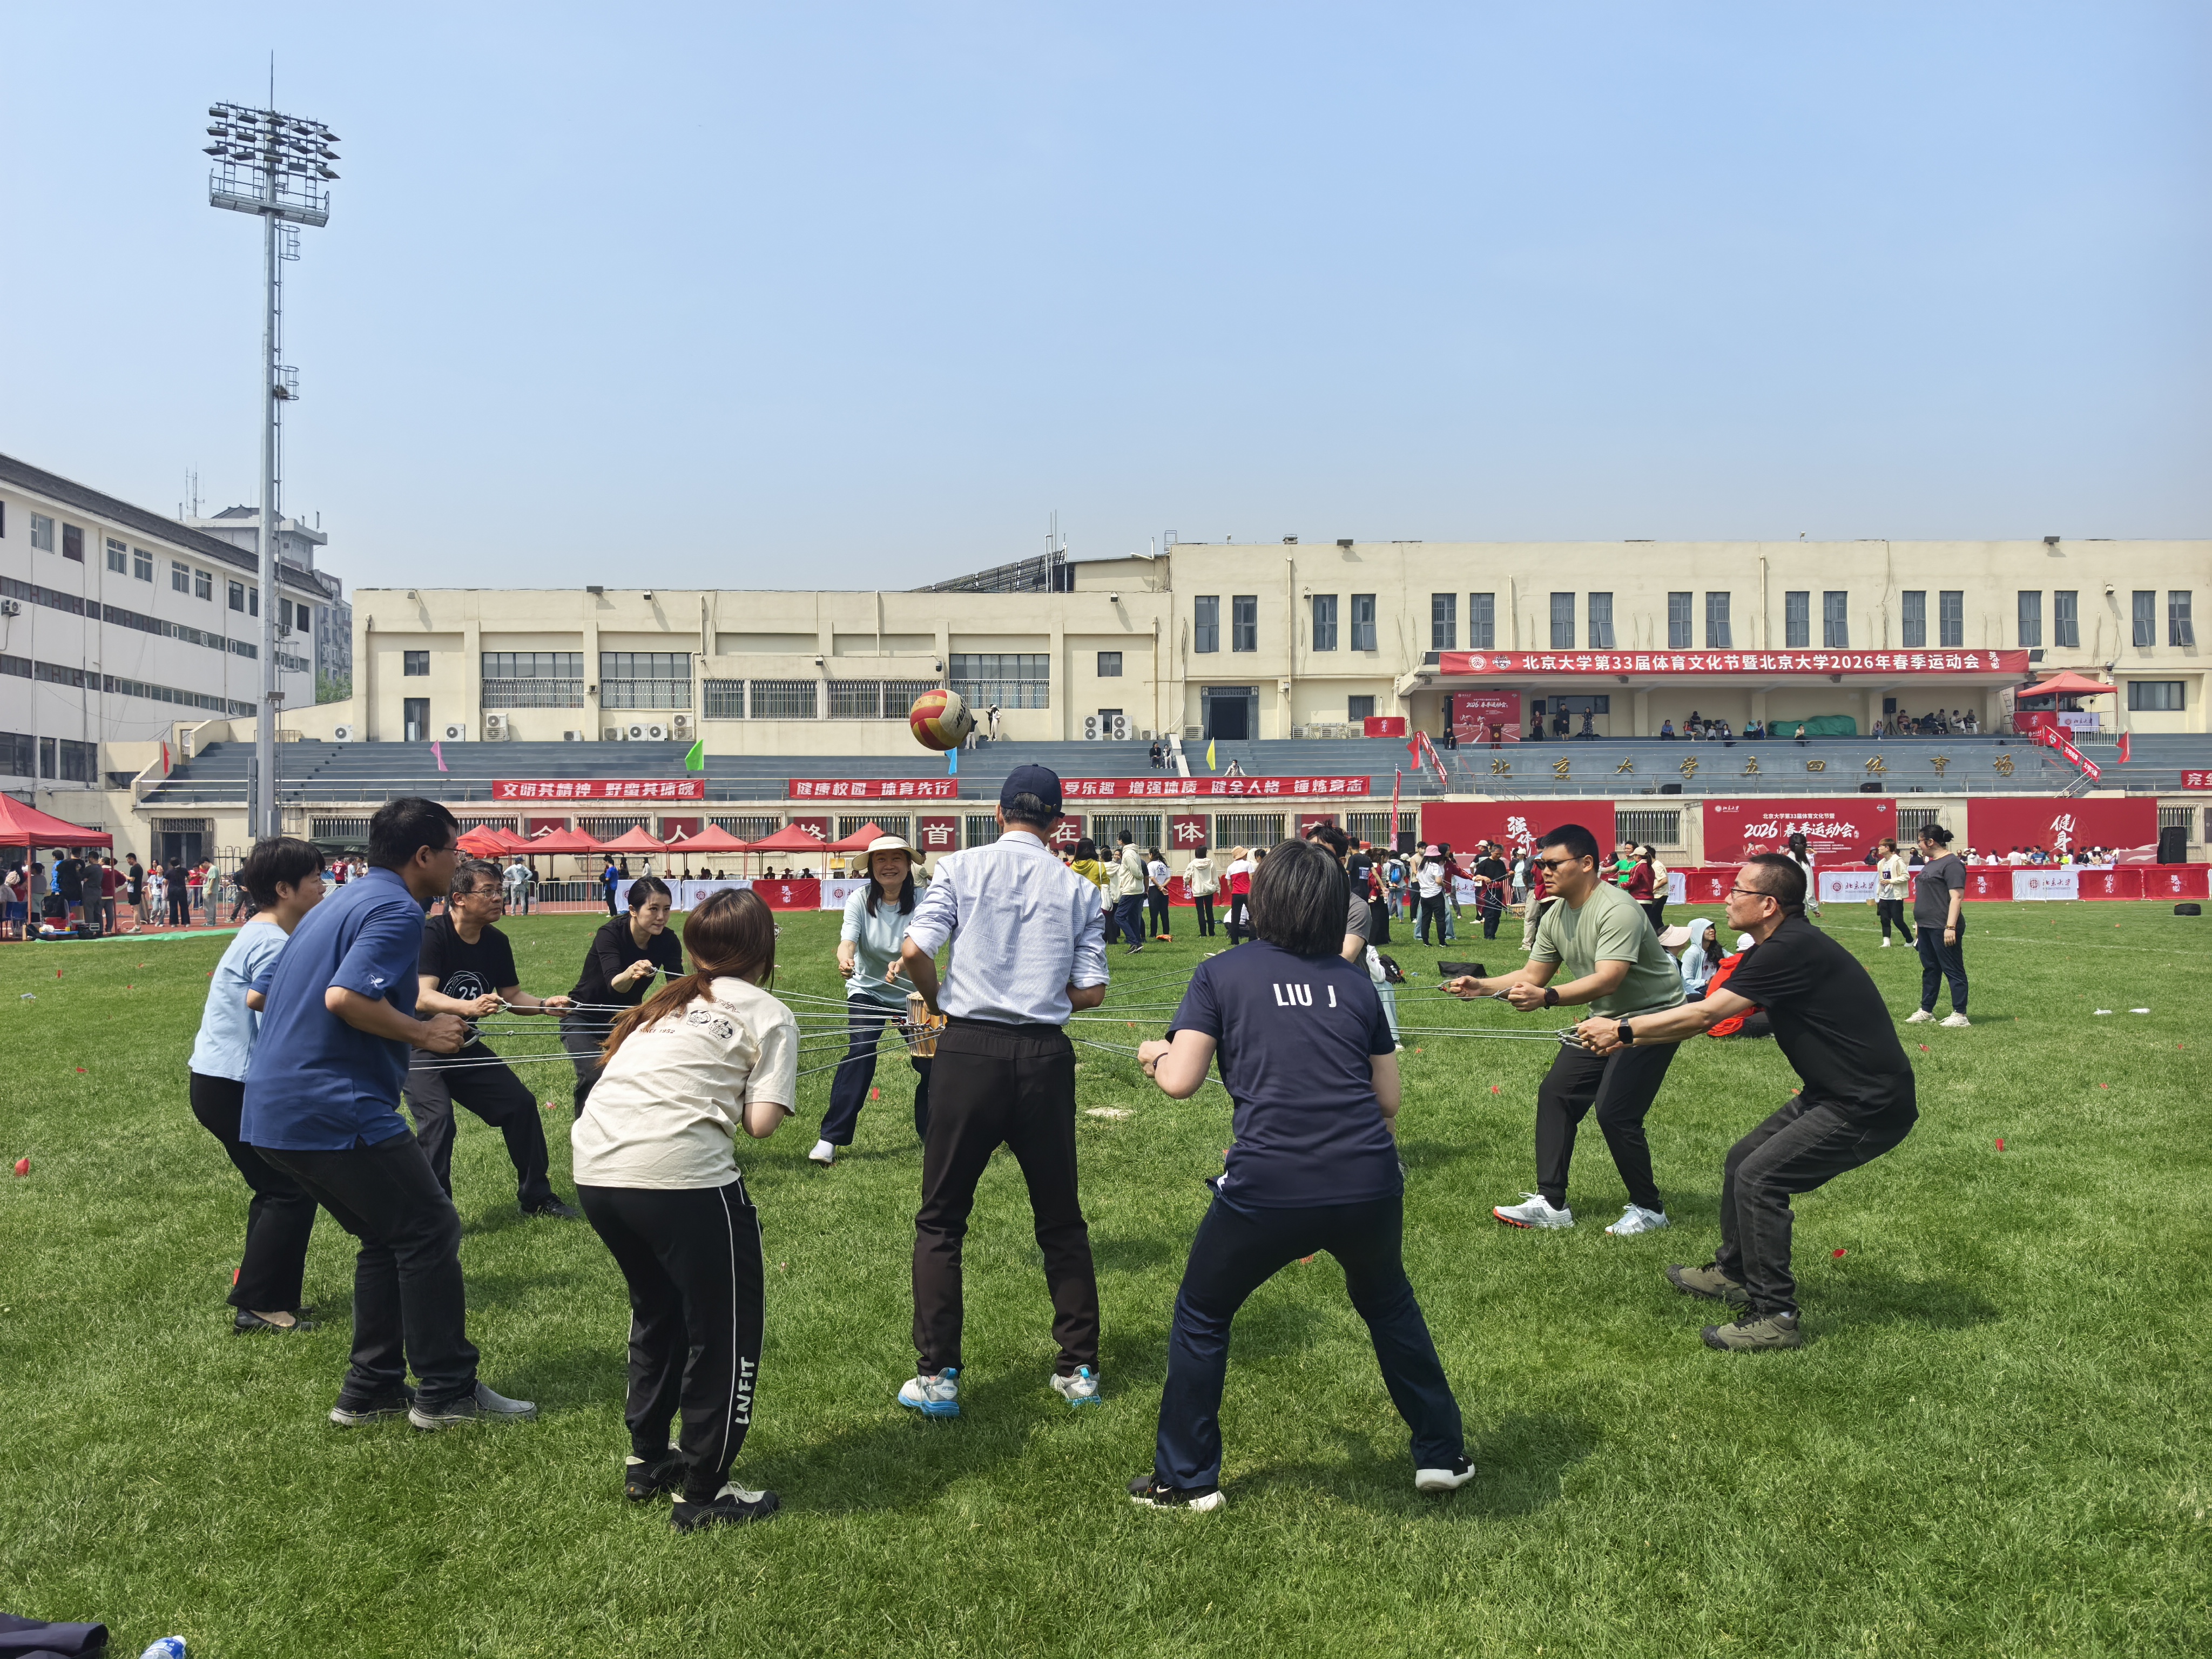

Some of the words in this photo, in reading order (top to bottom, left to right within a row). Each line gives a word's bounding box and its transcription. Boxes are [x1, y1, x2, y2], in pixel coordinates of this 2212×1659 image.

[1522, 654, 1980, 671] 北京大学第33届体育文化节暨北京大学2026年春季运动会
[502, 783, 591, 797] 文明其精神
[605, 782, 694, 796] 野蛮其体魄
[797, 782, 866, 795] 健康校园
[881, 782, 950, 795] 体育先行
[1061, 781, 1115, 794] 受乐趣
[1129, 781, 1197, 794] 增强体质
[1211, 780, 1280, 793] 健全人格
[1294, 779, 1363, 792] 锤炼意志
[922, 824, 954, 844] 首
[1050, 822, 1080, 843] 在
[1174, 822, 1205, 842] 体
[1744, 820, 1778, 838] 2026
[1783, 821, 1855, 838] 春季运动会
[2049, 813, 2076, 854] 健身
[1273, 983, 1312, 1006] LIU
[1327, 985, 1337, 1008] J
[735, 1357, 754, 1424] LNFIT
